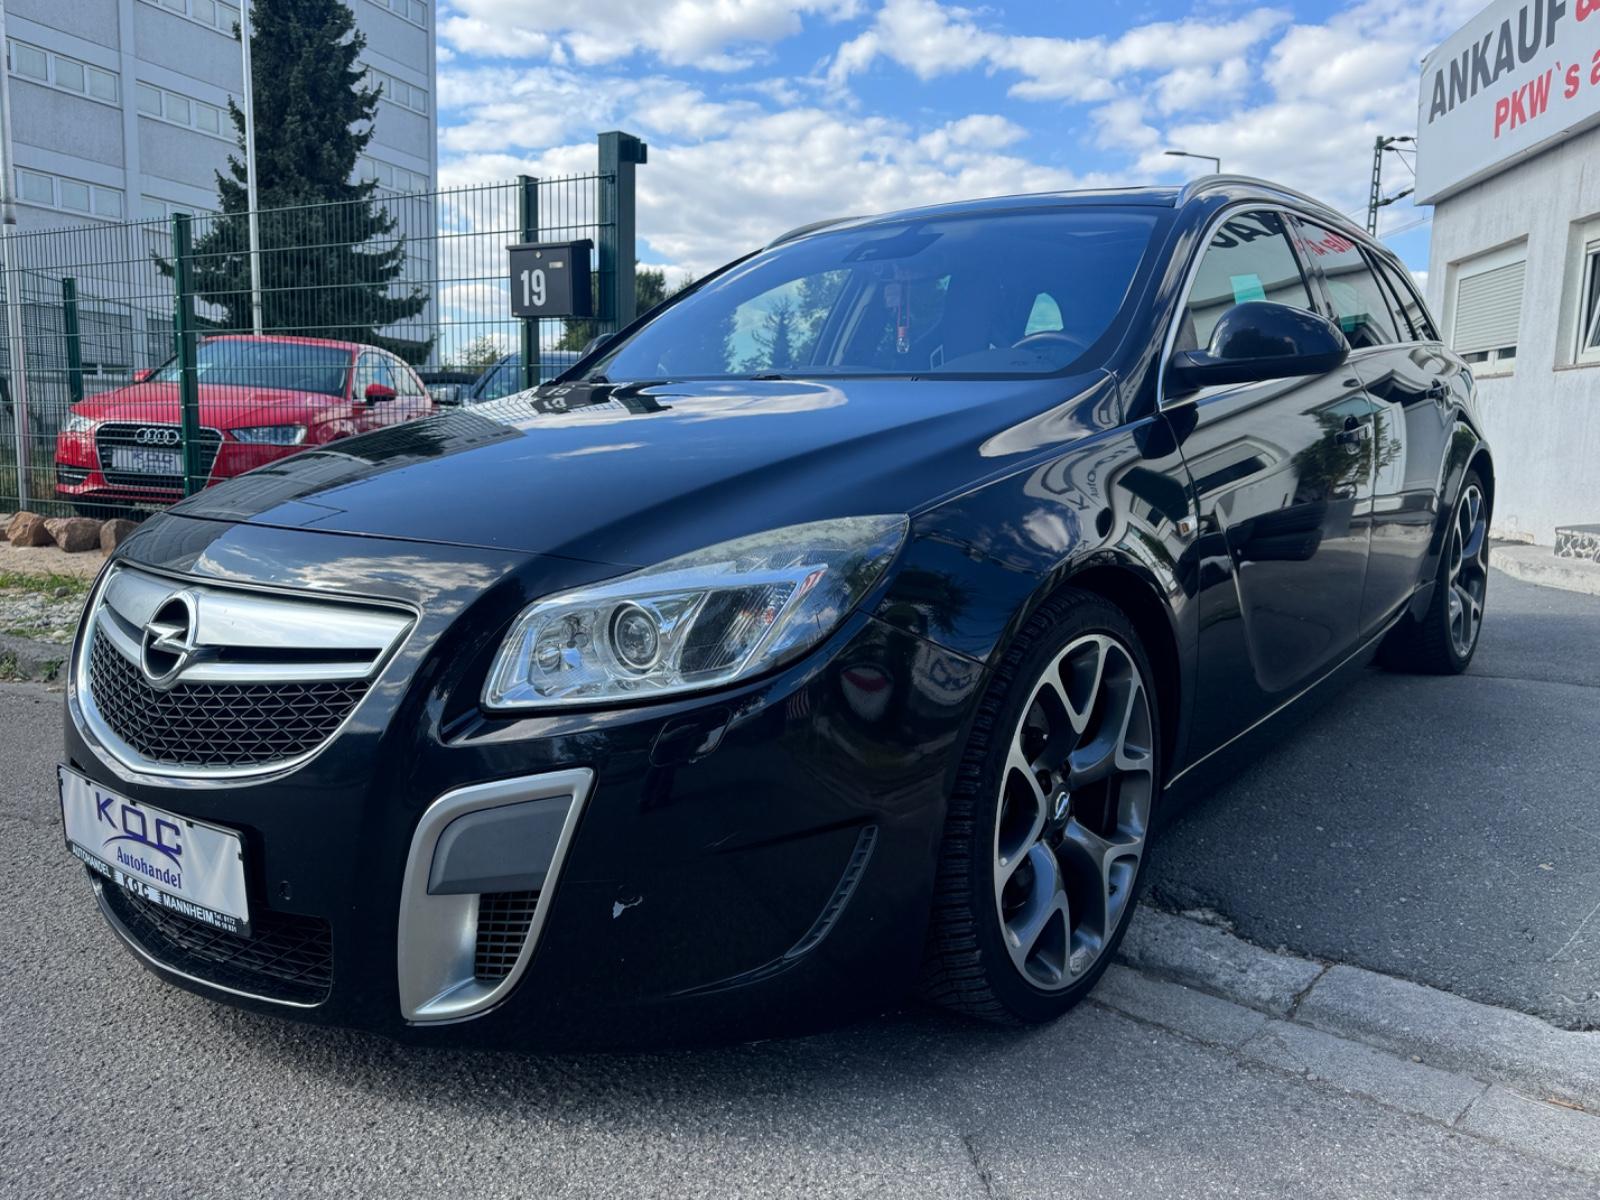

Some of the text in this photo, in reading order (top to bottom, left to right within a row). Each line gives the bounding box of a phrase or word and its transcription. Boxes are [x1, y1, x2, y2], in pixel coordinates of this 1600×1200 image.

[1428, 0, 1566, 124] ANKAUF
[520, 269, 546, 306] 19
[117, 846, 182, 889] Autohandel
[163, 893, 215, 924] MANNHEIM
